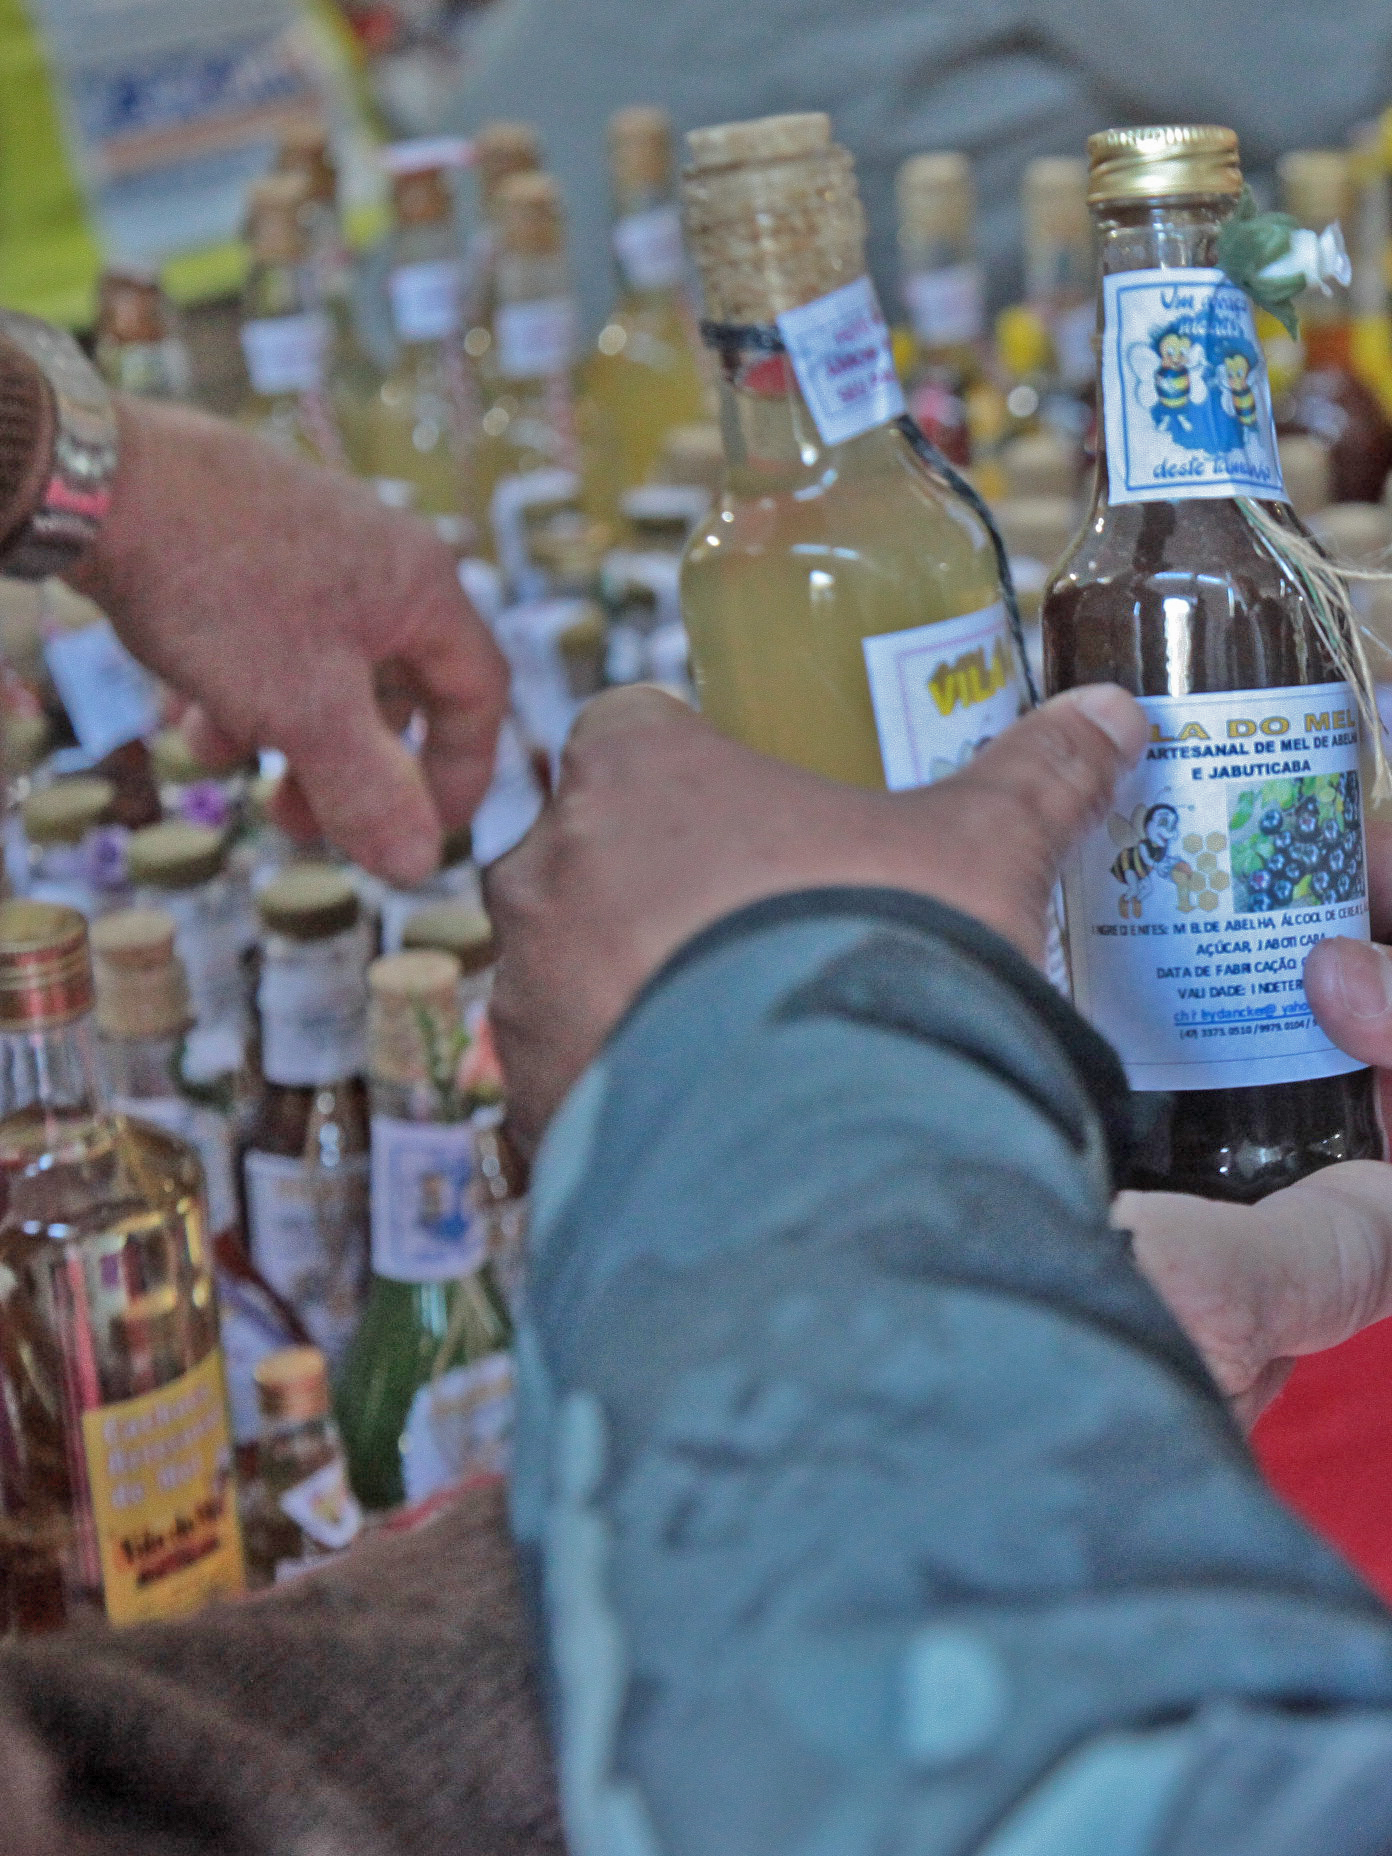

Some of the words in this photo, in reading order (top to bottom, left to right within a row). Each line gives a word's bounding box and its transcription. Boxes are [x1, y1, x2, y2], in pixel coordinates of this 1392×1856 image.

[1152, 457, 1208, 479] deste
[1149, 722, 1211, 743] LA
[1226, 715, 1290, 738] DO
[1303, 709, 1356, 733] MEL
[1147, 743, 1249, 761] ARTESANAL
[1254, 741, 1275, 754] DE
[1280, 737, 1310, 752] MEL
[1314, 735, 1329, 748] DE
[1332, 731, 1358, 748] ABELH
[1192, 767, 1203, 780] E
[1208, 760, 1312, 780] JABUTICABA
[1203, 920, 1220, 933] DE
[1325, 910, 1336, 922] DE
[1156, 966, 1192, 979] DATA
[1194, 965, 1210, 978] DE
[1251, 979, 1303, 994] INDETER
